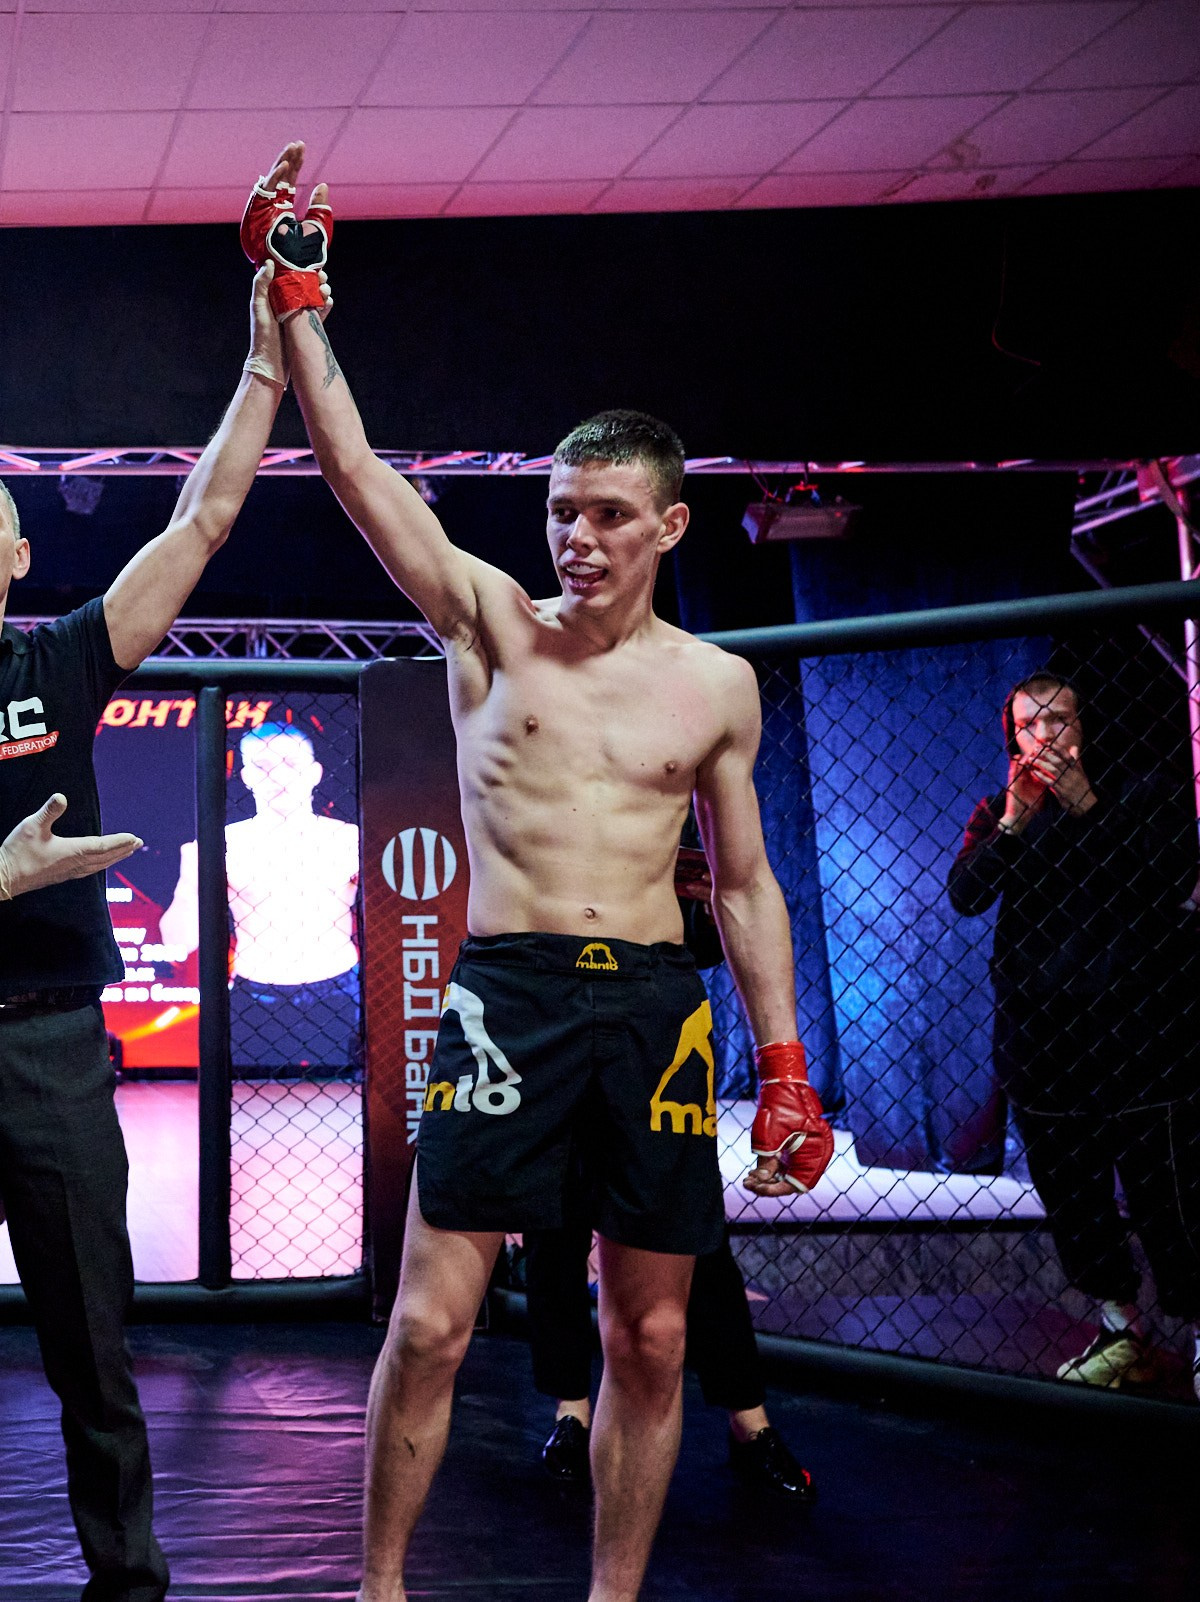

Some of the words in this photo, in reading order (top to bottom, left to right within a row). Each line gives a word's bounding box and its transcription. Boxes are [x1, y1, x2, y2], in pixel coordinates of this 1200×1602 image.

[1, 734, 58, 756] FEDERATION
[401, 914, 441, 1021] НБД
[575, 960, 619, 971] manto
[422, 1073, 522, 1116] nto
